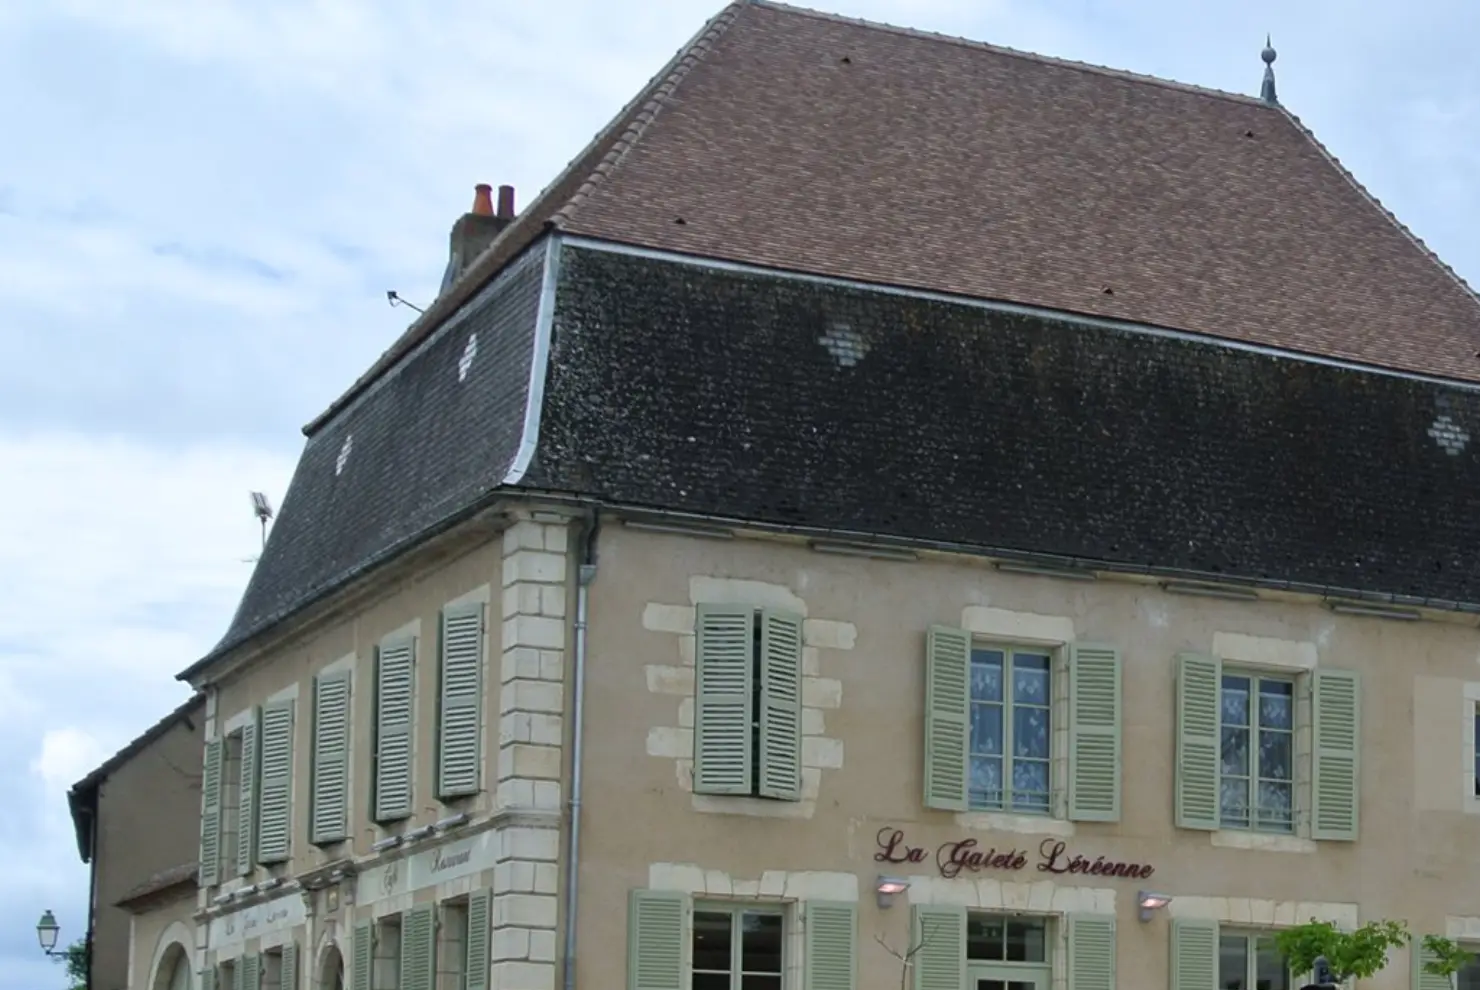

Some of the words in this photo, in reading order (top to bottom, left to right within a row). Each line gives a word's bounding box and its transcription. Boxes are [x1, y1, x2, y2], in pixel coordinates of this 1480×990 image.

[874, 826, 928, 864] La
[936, 838, 1028, 879] Gaieté
[1036, 838, 1155, 879] Léréenne
